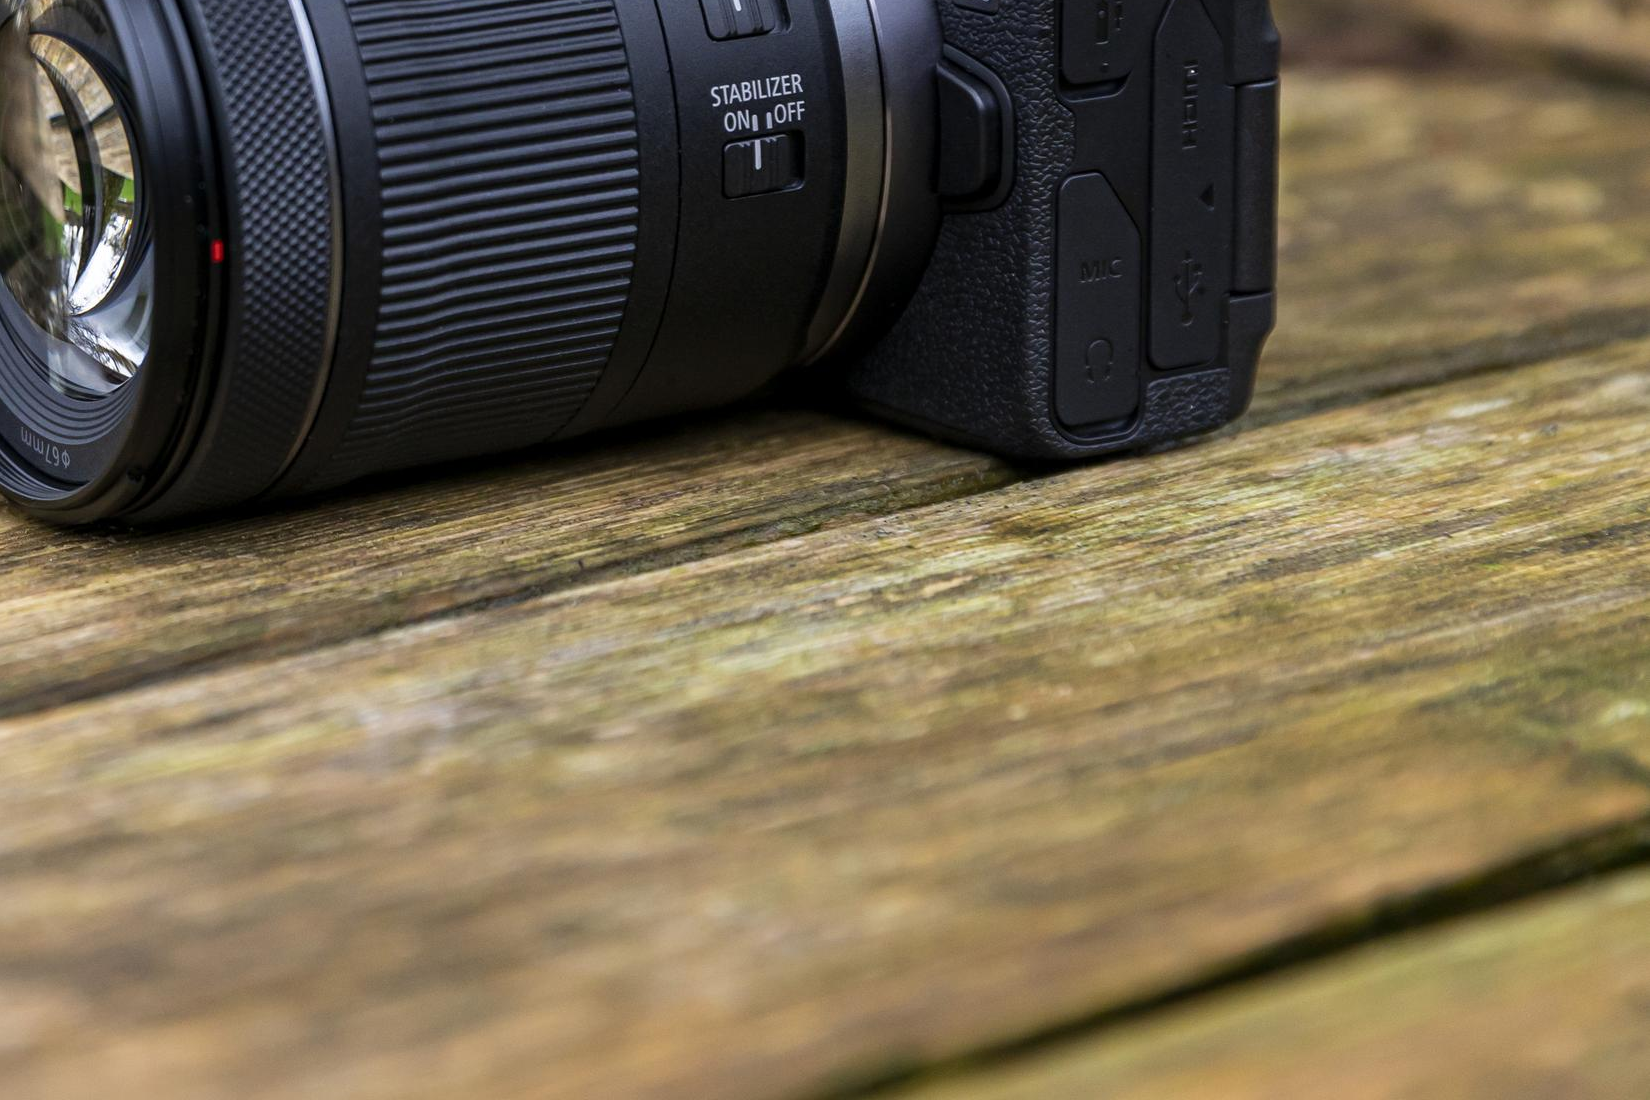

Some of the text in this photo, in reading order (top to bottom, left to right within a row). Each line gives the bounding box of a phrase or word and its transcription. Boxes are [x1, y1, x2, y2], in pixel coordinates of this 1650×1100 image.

[710, 73, 804, 108] STABILIZER
[1181, 57, 1199, 150] HDMI
[723, 101, 806, 133] ON OFF
[1078, 257, 1123, 284] MIC
